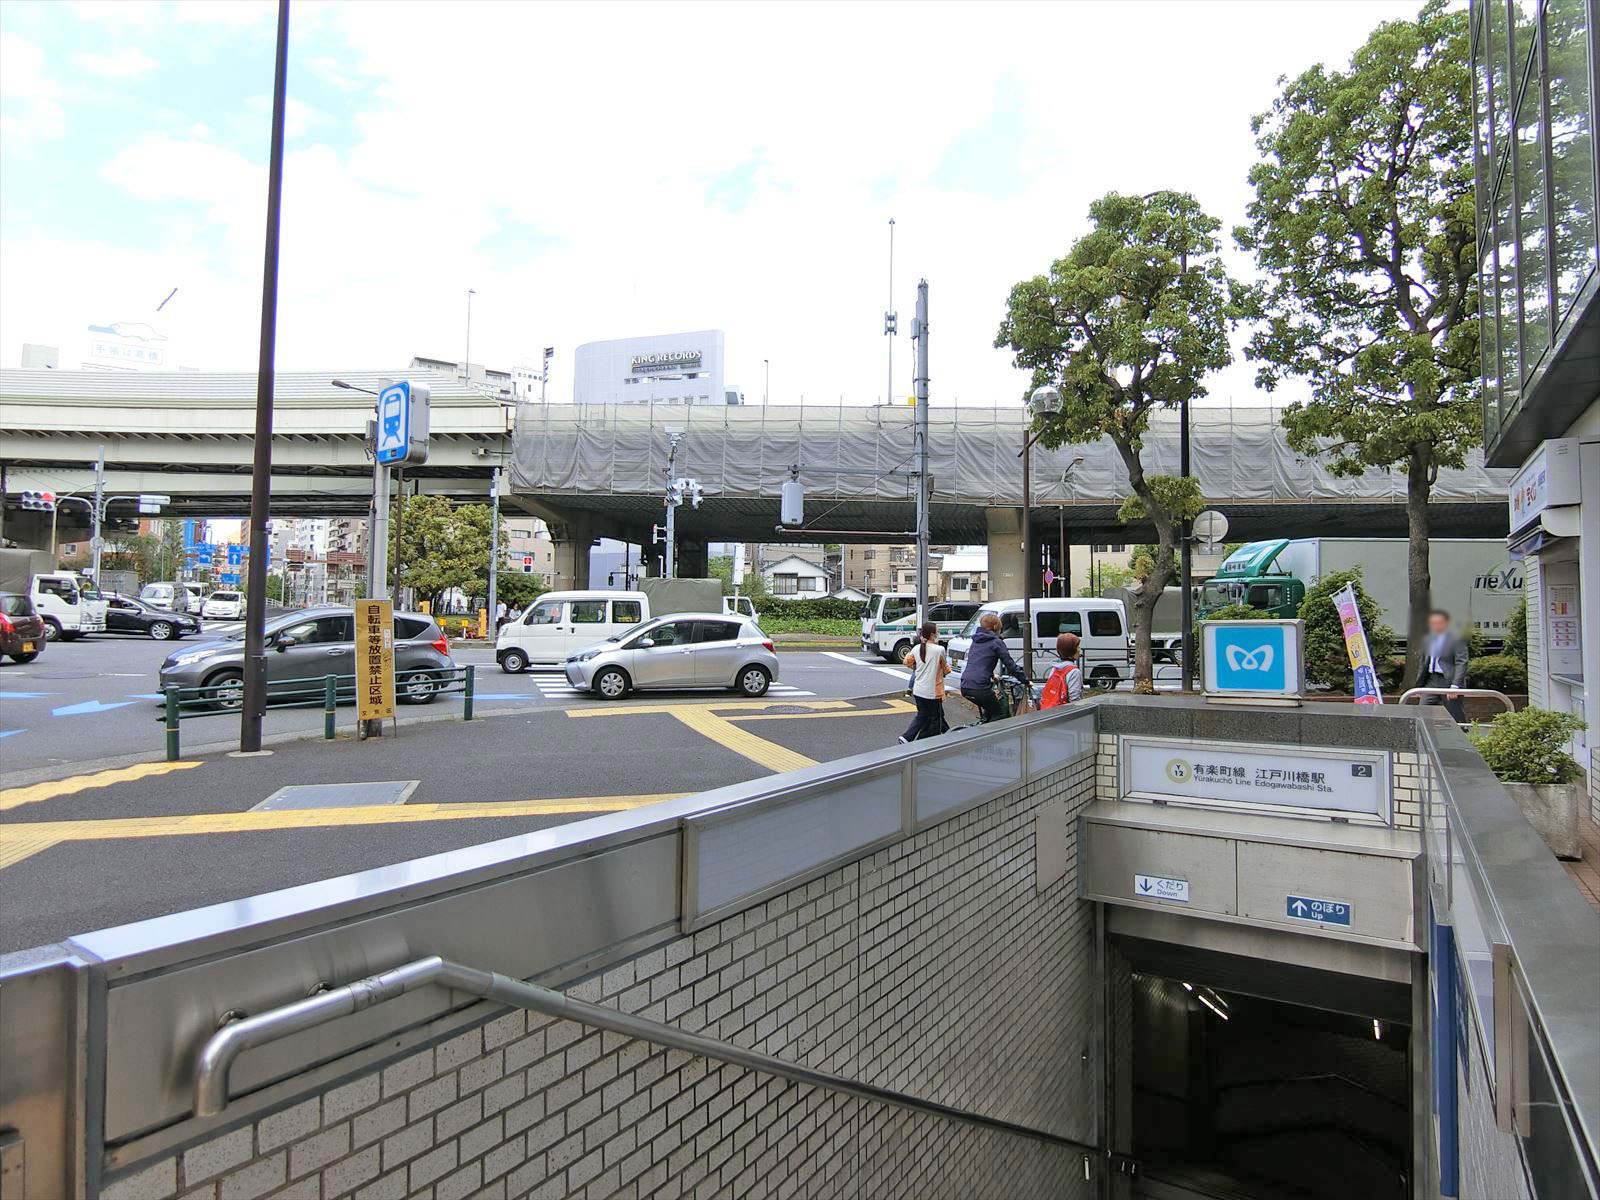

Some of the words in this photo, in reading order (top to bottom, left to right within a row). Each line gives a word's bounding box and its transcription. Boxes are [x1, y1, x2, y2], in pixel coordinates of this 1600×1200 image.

[631, 354, 656, 364] KING
[657, 350, 702, 362] RECORDS
[1474, 568, 1525, 589] neXu
[367, 605, 382, 705] 自転車等放置禁止区域
[1193, 764, 1246, 778] 有楽町線
[1255, 768, 1326, 785] 江戸川橋駅
[1357, 765, 1367, 777] 2
[1235, 778, 1252, 786] Line
[1255, 779, 1315, 791] Edogawabashi
[1316, 784, 1335, 793] Sta.
[1156, 879, 1184, 891] くだり
[1156, 889, 1178, 897] Down
[1311, 901, 1345, 915] のぼり
[1311, 911, 1324, 920] Up
